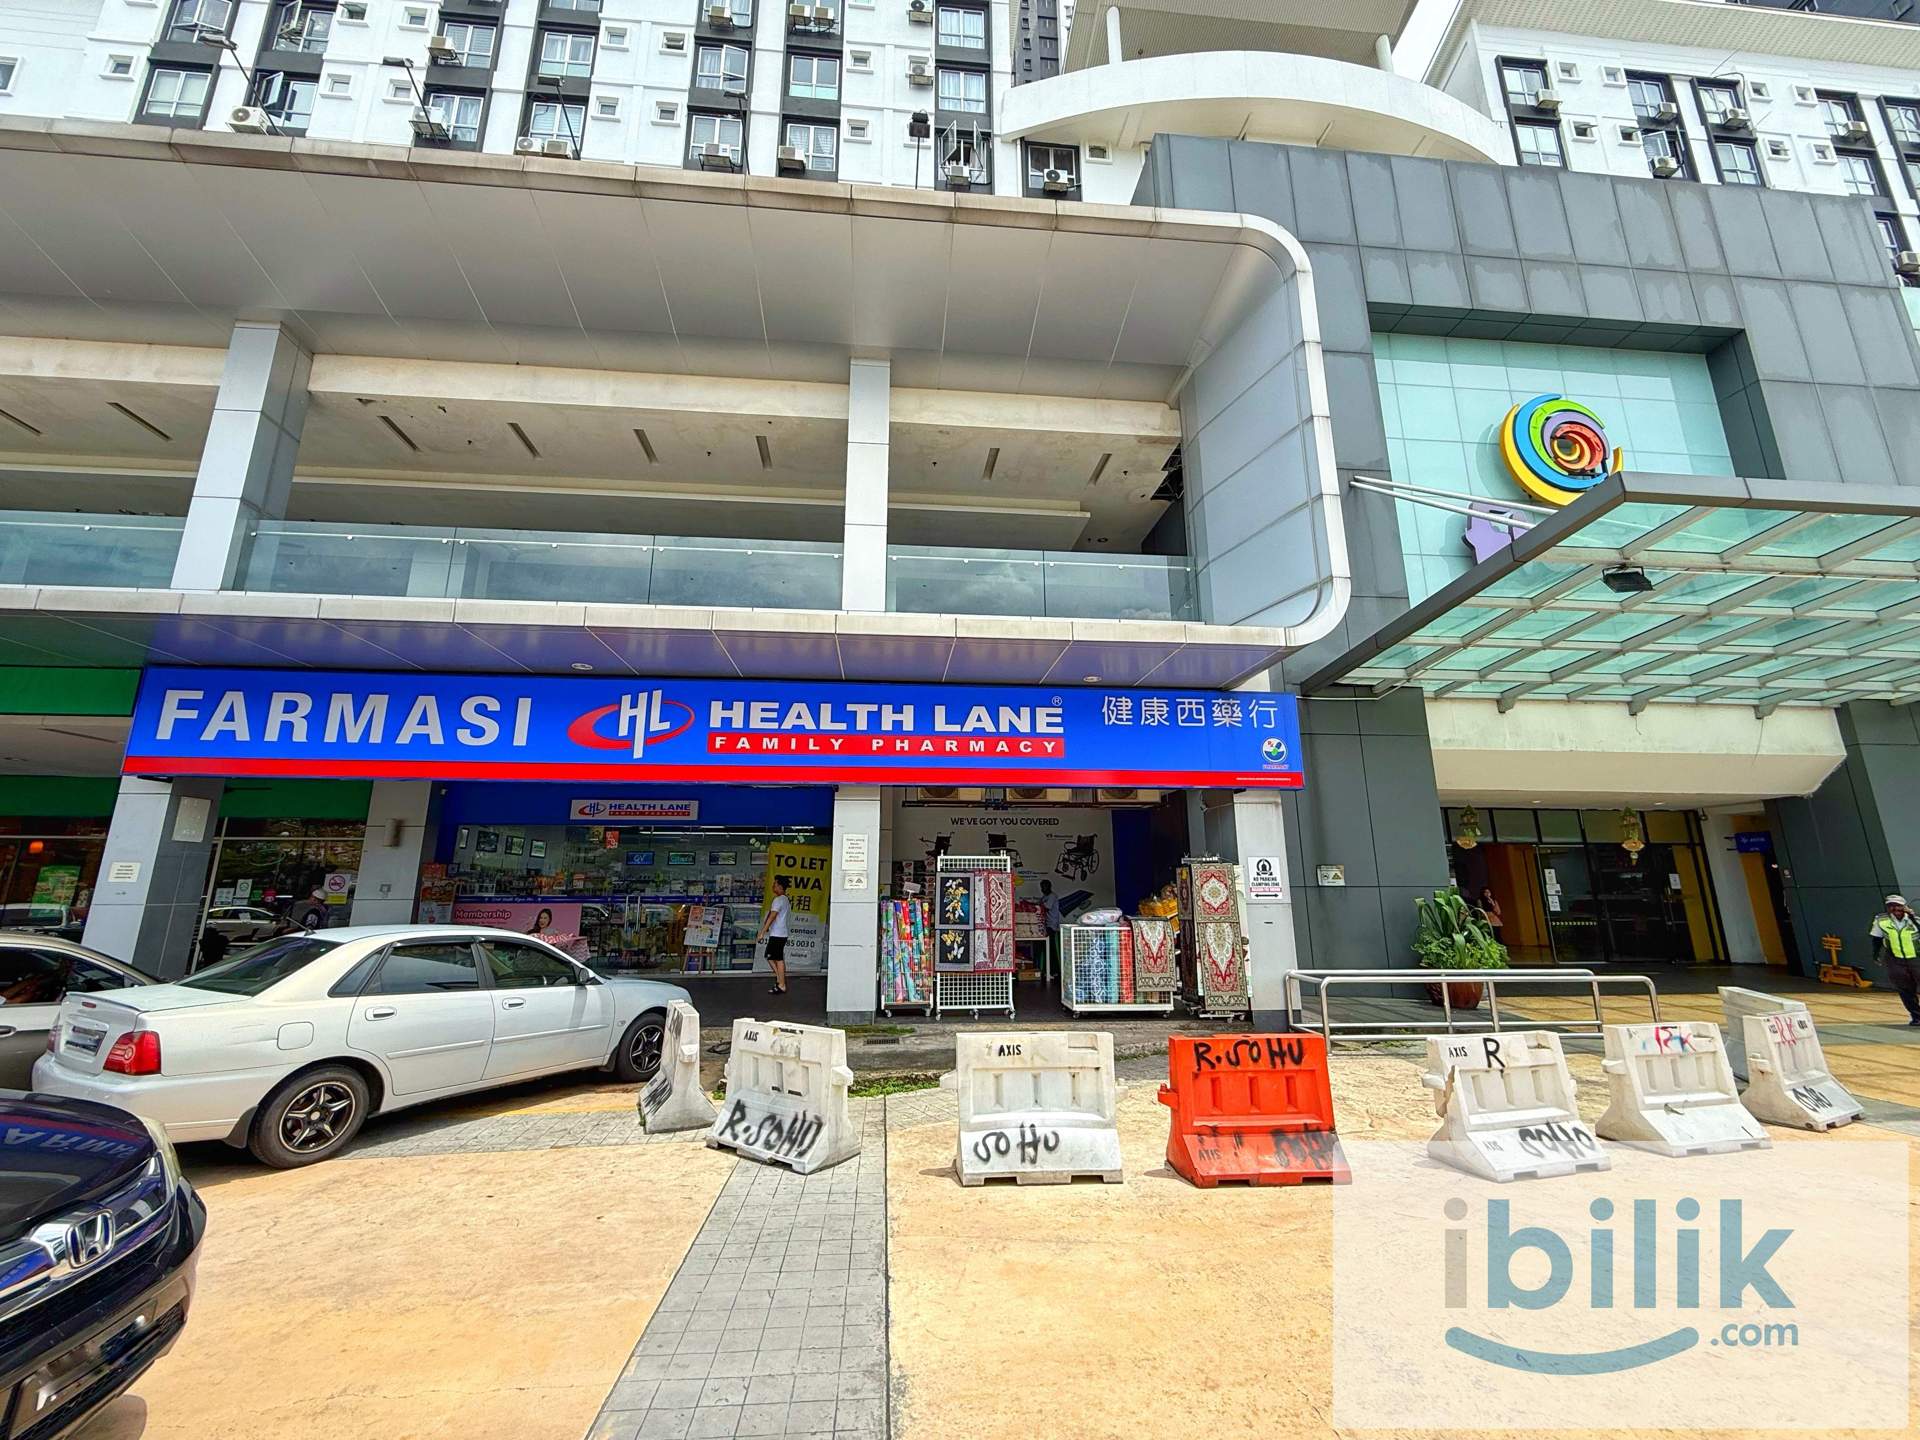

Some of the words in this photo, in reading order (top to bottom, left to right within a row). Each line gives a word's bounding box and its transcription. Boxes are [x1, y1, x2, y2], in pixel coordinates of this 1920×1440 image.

[155, 688, 532, 747] FARMASI
[709, 700, 916, 732] HEALTH
[934, 706, 1064, 734] LANE
[1102, 695, 1278, 729] 健康西藥行
[714, 736, 844, 751] FAMILY
[871, 739, 1057, 754] PHARMACY
[950, 817, 978, 827] WE'VE
[979, 818, 998, 827] GOT
[1000, 818, 1018, 827] YOU
[1019, 818, 1060, 827] COVERED
[775, 854, 797, 868] TO
[800, 857, 828, 871] LET
[784, 875, 822, 891] EWA
[455, 908, 511, 919] Membership
[744, 1030, 759, 1042] AXIS
[998, 1044, 1022, 1056] AXIS
[1448, 1046, 1468, 1057] AXIS
[1483, 1037, 1505, 1068] R
